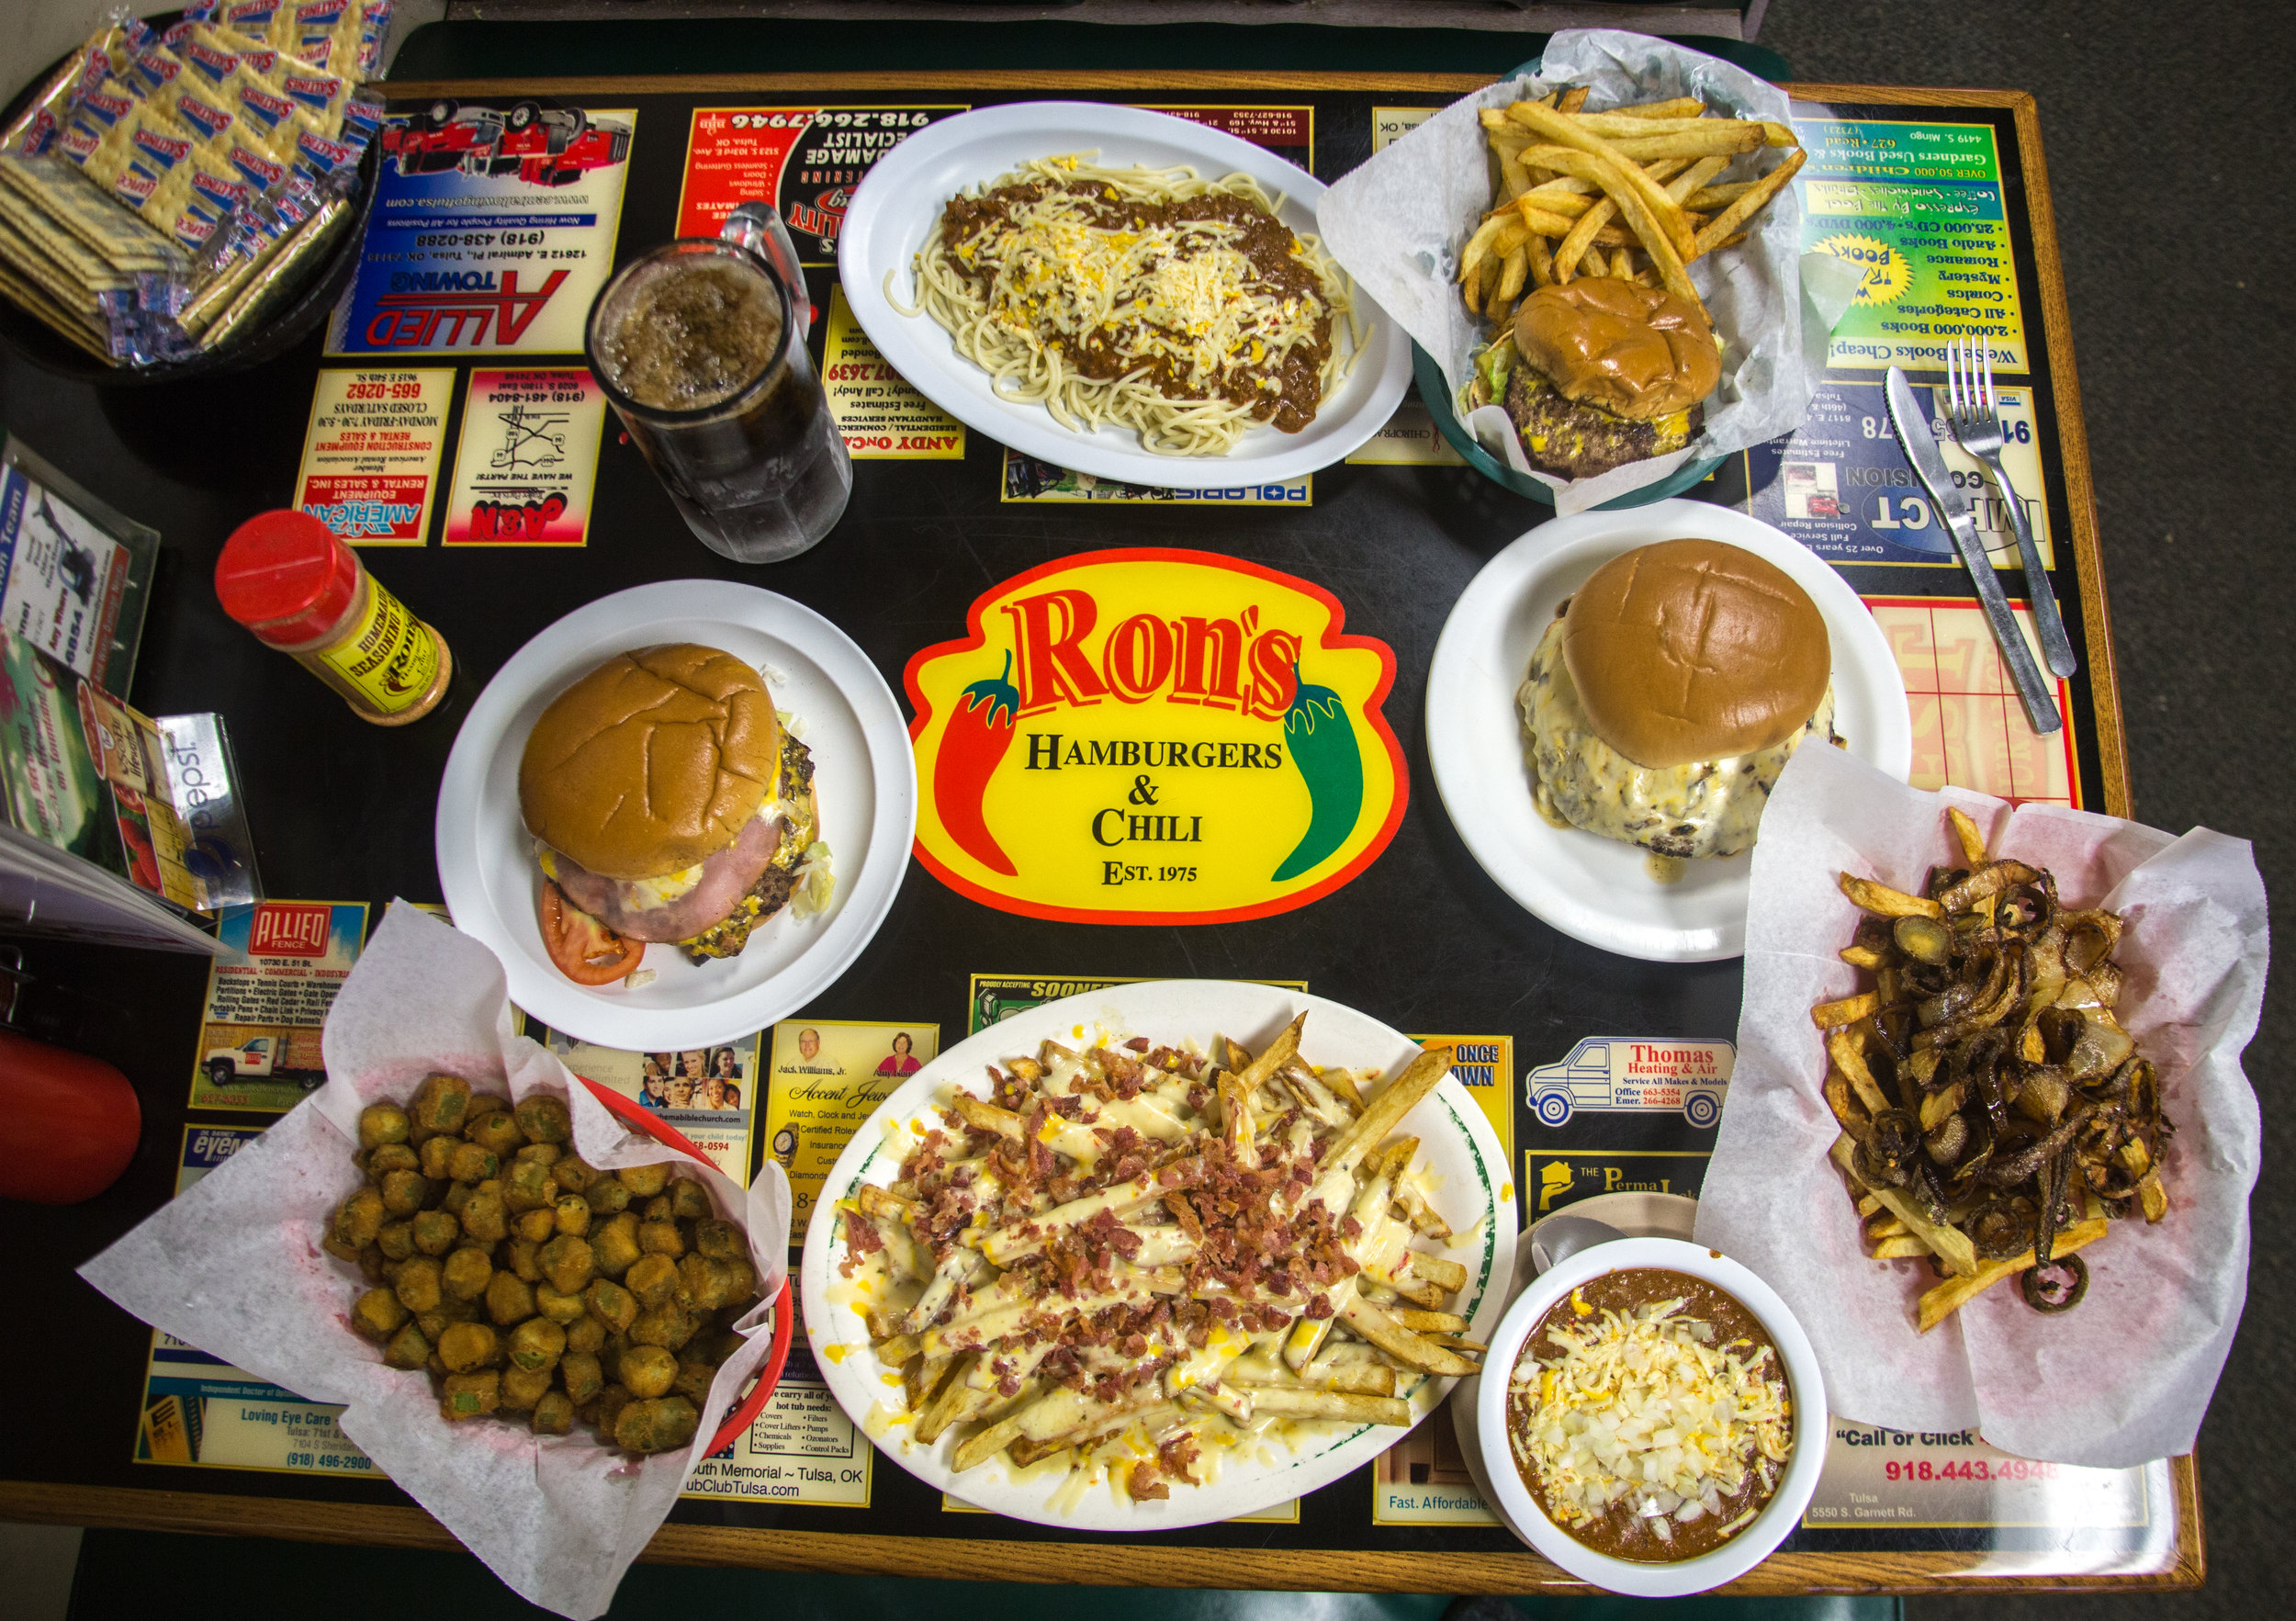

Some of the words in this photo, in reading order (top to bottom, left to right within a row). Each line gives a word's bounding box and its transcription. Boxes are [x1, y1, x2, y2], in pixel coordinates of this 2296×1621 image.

[187, 43, 241, 77] SALTINES
[283, 77, 342, 99] SALTINES
[240, 87, 297, 120] SALTINES
[179, 94, 233, 132] SALTINES
[732, 112, 929, 129] 918.266.7946
[1380, 122, 1399, 131] OK
[1909, 131, 1941, 141] Mingo
[1957, 134, 1981, 143] 4419
[137, 129, 192, 162] SALTINES
[1825, 137, 1860, 147] Read
[1871, 139, 1896, 148] 627
[1815, 150, 1826, 159] &
[1830, 150, 1874, 161] Books
[1878, 151, 1915, 162] Used
[1919, 152, 1986, 164] Gardners
[1806, 164, 1909, 175] Children's
[1914, 167, 1953, 178] 50,000
[1956, 168, 1986, 178] OVER
[388, 219, 428, 228] Positions
[461, 217, 492, 226] People
[495, 217, 526, 226] Quality
[529, 216, 557, 226] Hiring
[1944, 221, 1994, 233] 25,000
[417, 234, 495, 246] 438-0288
[501, 231, 545, 245] (918)
[1900, 238, 1948, 249] Books
[1953, 240, 1996, 250] Audio
[488, 251, 534, 260] Admiral
[1829, 243, 1889, 265] BOOKS
[1927, 255, 1998, 267] Romance
[390, 272, 496, 290] TOWING
[1938, 271, 2000, 284] Mystery
[1947, 290, 2003, 301] Comics
[366, 270, 570, 346] ALLIED
[1896, 305, 1981, 319] Categories
[1984, 309, 2005, 319] All
[1881, 321, 1930, 333] Books
[1933, 323, 2008, 336] 2,000,000
[1829, 343, 1891, 363] Cheap!
[1896, 347, 1947, 361] Books
[1988, 349, 2018, 364] We
[346, 383, 421, 399] 665-0262
[552, 391, 585, 402] (918)
[834, 385, 862, 397] Andy!
[866, 388, 884, 397] Call
[489, 393, 547, 402] 461-8404
[333, 403, 388, 413] SATURDAYS
[390, 403, 427, 412] CLOSED
[850, 401, 901, 410] Estimates
[904, 401, 926, 410] Free
[363, 416, 438, 426] MONDAY-FRIDAY
[380, 432, 411, 440] RENTAL
[314, 443, 365, 451] EQUIPMENT
[367, 442, 432, 451] CONSTRUCTION
[896, 436, 958, 449] ANDY
[1810, 439, 1851, 447] Lifetime
[1771, 448, 1820, 457] Estimates
[1823, 449, 1844, 457] Free
[310, 479, 331, 488] INC.
[334, 479, 367, 488] SALES
[383, 479, 424, 488] RENTAL
[332, 490, 396, 499] EQUIPMENT
[2, 490, 23, 545] Team
[303, 502, 422, 523] AMERICAN
[469, 492, 568, 540] A&N
[1780, 521, 1812, 530] Repair
[1815, 522, 1857, 531] Collision
[1790, 532, 1829, 541] Service
[1832, 533, 1849, 542] Full
[1816, 543, 1842, 553] years
[1846, 545, 1858, 553] 25
[1861, 546, 1884, 554] Over
[53, 587, 69, 625] Where
[48, 625, 62, 651] Any
[349, 610, 400, 678] SEASONING
[1000, 589, 1302, 722] Ron's
[1024, 733, 1282, 771] HAMBURGERS
[1128, 774, 1159, 806] &
[1092, 808, 1202, 848] CHILI
[1101, 861, 1151, 886] EST.
[1158, 866, 1198, 882] 1975
[256, 911, 325, 947] ALLIED
[272, 940, 306, 949] FENCE
[219, 977, 250, 986] Backstops
[1002, 981, 1030, 989] ACCEPTING
[217, 986, 246, 996] Partitions
[217, 996, 239, 1005] Rolling
[209, 1004, 235, 1012] Portable
[1457, 1044, 1499, 1063] ONCE
[1630, 1044, 1714, 1064] Thomas
[778, 1065, 797, 1074] Jack
[799, 1066, 834, 1076] Williams,
[838, 1067, 847, 1075] Jr.
[1628, 1062, 1678, 1076] Heating
[1682, 1064, 1693, 1075] &
[1696, 1064, 1717, 1075] Air
[1623, 1077, 1649, 1086] Service
[790, 1079, 846, 1101] Accent
[1615, 1087, 1640, 1096] Office
[790, 1109, 815, 1120] Watch,
[817, 1110, 838, 1120] Clock
[801, 1125, 833, 1134] Certified
[790, 1171, 827, 1180] Diamonds
[1581, 1167, 1599, 1176] THE
[1604, 1167, 1658, 1191] Perma
[781, 1391, 802, 1401] carry
[807, 1403, 831, 1412] needs:
[242, 1408, 278, 1424] Loving
[281, 1411, 301, 1425] Eye
[306, 1412, 331, 1425] Care
[760, 1422, 777, 1430] Cover
[807, 1424, 828, 1433] Pumps
[806, 1435, 838, 1443] Ozonators
[1893, 1433, 1914, 1446] or
[805, 1445, 828, 1453] Control
[831, 1446, 849, 1454] Packs
[287, 1452, 314, 1467] (918)
[319, 1454, 371, 1469] 496-2900
[722, 1466, 782, 1479] Memorial
[798, 1468, 836, 1484] Tulsa,
[840, 1470, 863, 1482] OK
[686, 1480, 799, 1496] ubClubTulsa.com
[1390, 1496, 1418, 1509] Fast.
[1423, 1496, 1491, 1510] Affordable.
[1849, 1492, 1878, 1503] Tulsa
[1812, 1507, 1838, 1518] 5550
[1855, 1507, 1895, 1518] Garnett
